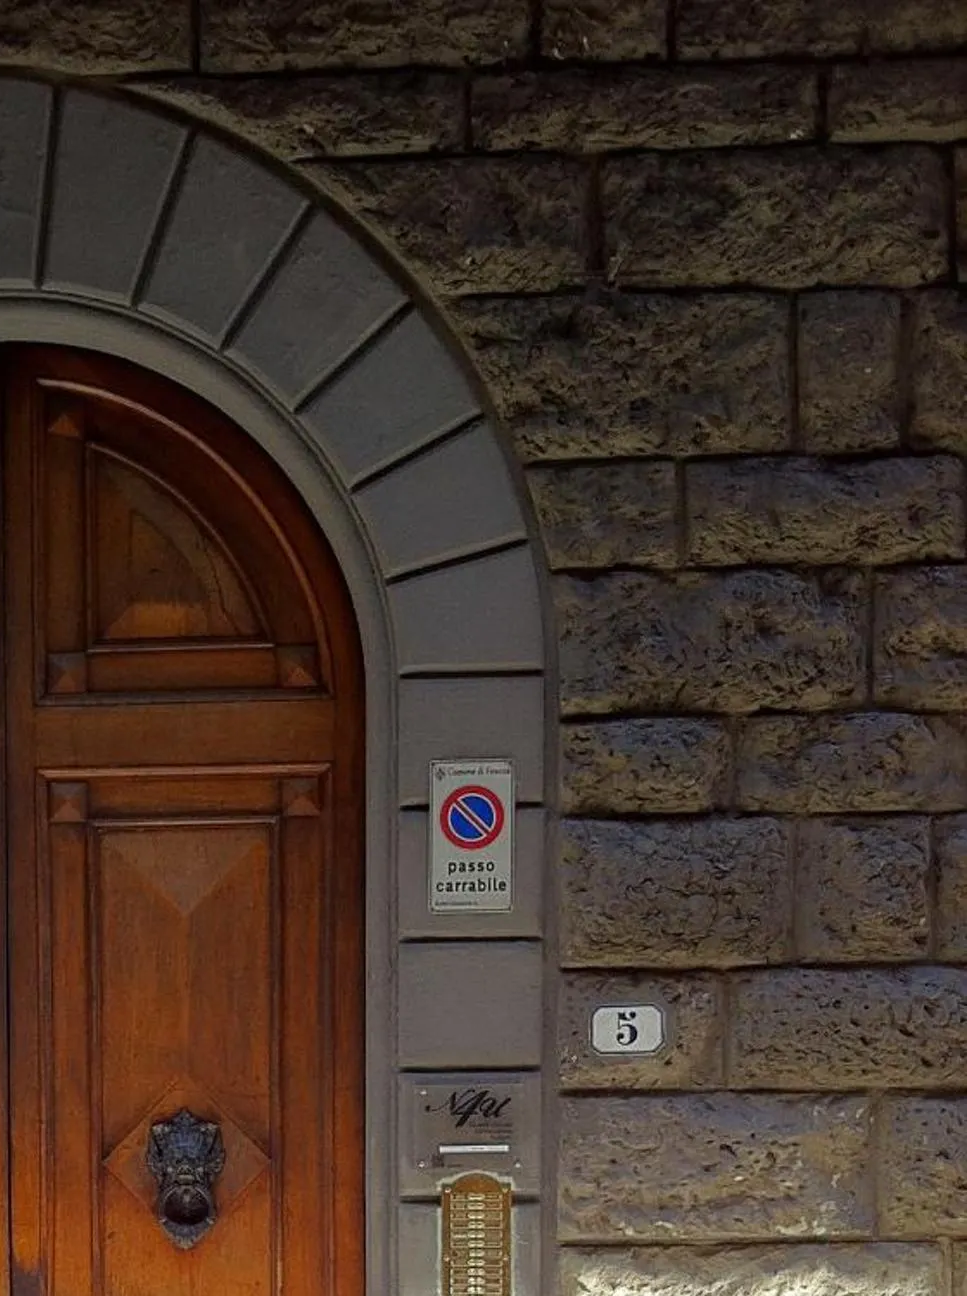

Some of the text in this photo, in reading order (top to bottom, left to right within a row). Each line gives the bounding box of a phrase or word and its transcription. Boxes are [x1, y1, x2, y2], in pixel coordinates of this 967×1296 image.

[447, 861, 495, 875] passo
[436, 878, 507, 893] carrabile
[616, 1011, 638, 1046] 5
